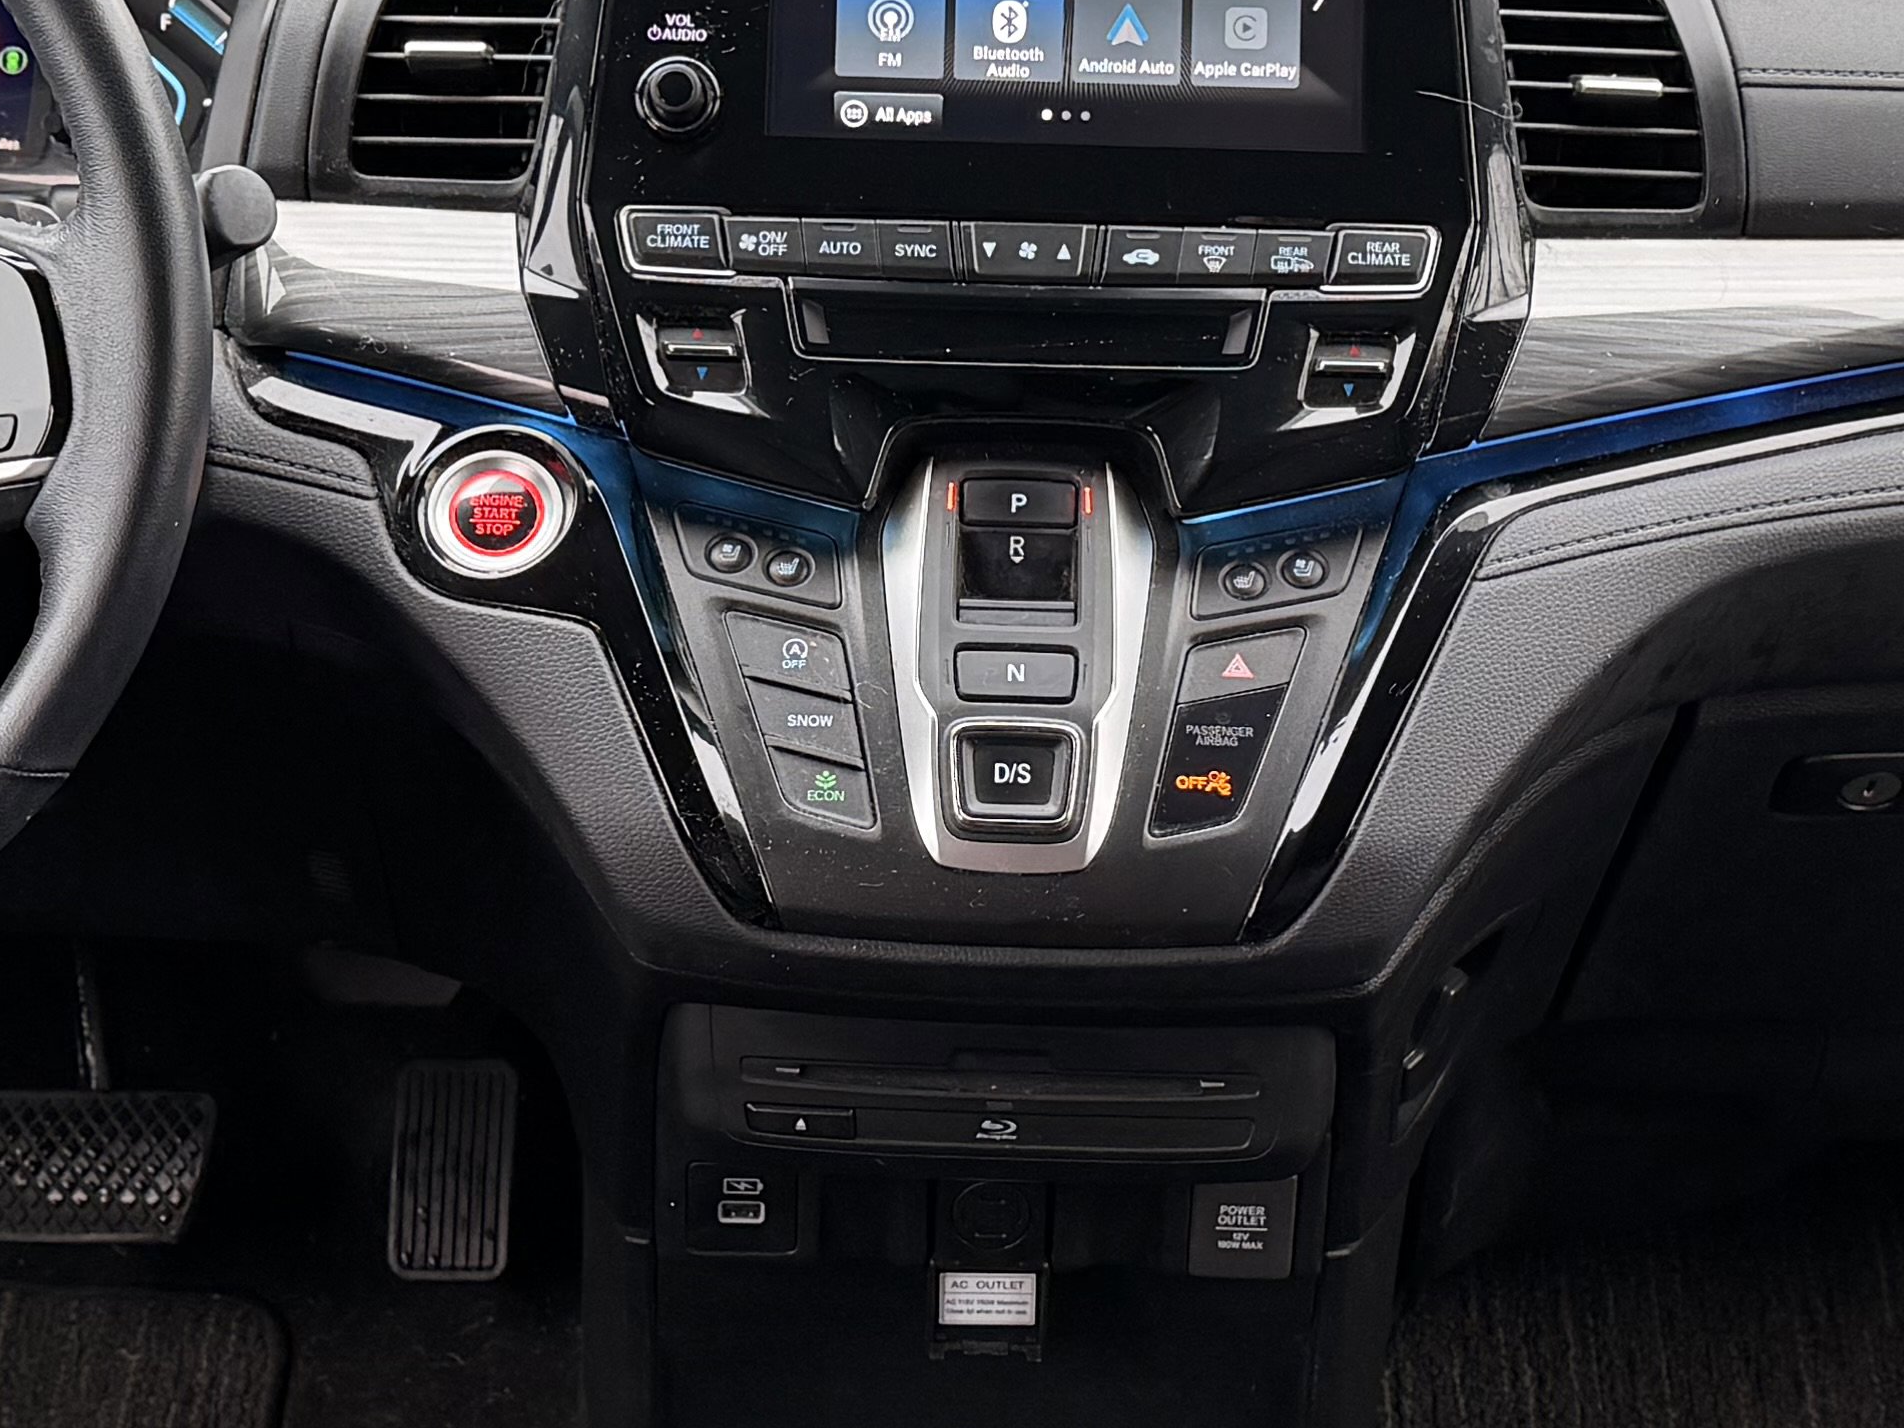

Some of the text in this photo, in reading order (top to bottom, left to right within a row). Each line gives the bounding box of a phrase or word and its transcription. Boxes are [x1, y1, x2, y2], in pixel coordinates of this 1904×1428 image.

[160, 13, 172, 31] F
[665, 13, 696, 28] VOL
[662, 29, 708, 42] AUDIO
[878, 52, 902, 67] FM
[973, 45, 1045, 63] Bluetooth
[986, 62, 1031, 79] Audio
[1078, 58, 1175, 76] Android Auto
[1194, 61, 1298, 81] Apple CarPlay
[875, 106, 933, 126] All Apps
[657, 223, 701, 236] FRONT
[646, 235, 710, 249] CLIMATE
[758, 231, 788, 244] ON/
[758, 243, 788, 256] OFF
[818, 241, 862, 256] AUTO
[894, 243, 937, 258] SYNC
[1198, 244, 1235, 258] FRONT
[1278, 245, 1309, 257] REAR
[1365, 241, 1401, 255] REAR
[1347, 252, 1412, 268] CLIMATE
[469, 494, 526, 508] ENGINE
[1010, 493, 1028, 513] P
[473, 507, 520, 520] START
[474, 523, 515, 536] STOP
[1009, 536, 1025, 557] R
[782, 659, 807, 670] OFF
[1007, 663, 1026, 683] N
[787, 714, 834, 728] SNOW
[1185, 724, 1254, 738] PASSENGER
[1195, 735, 1239, 747] AIRBAG
[993, 762, 1032, 784] D/S
[1176, 775, 1208, 789] OFF
[807, 789, 846, 802] ECON
[1219, 1204, 1266, 1216] POWER
[1217, 1215, 1267, 1227] OUTLET
[1241, 1241, 1264, 1250] MAX
[950, 1280, 1025, 1290] AC OUTLET
